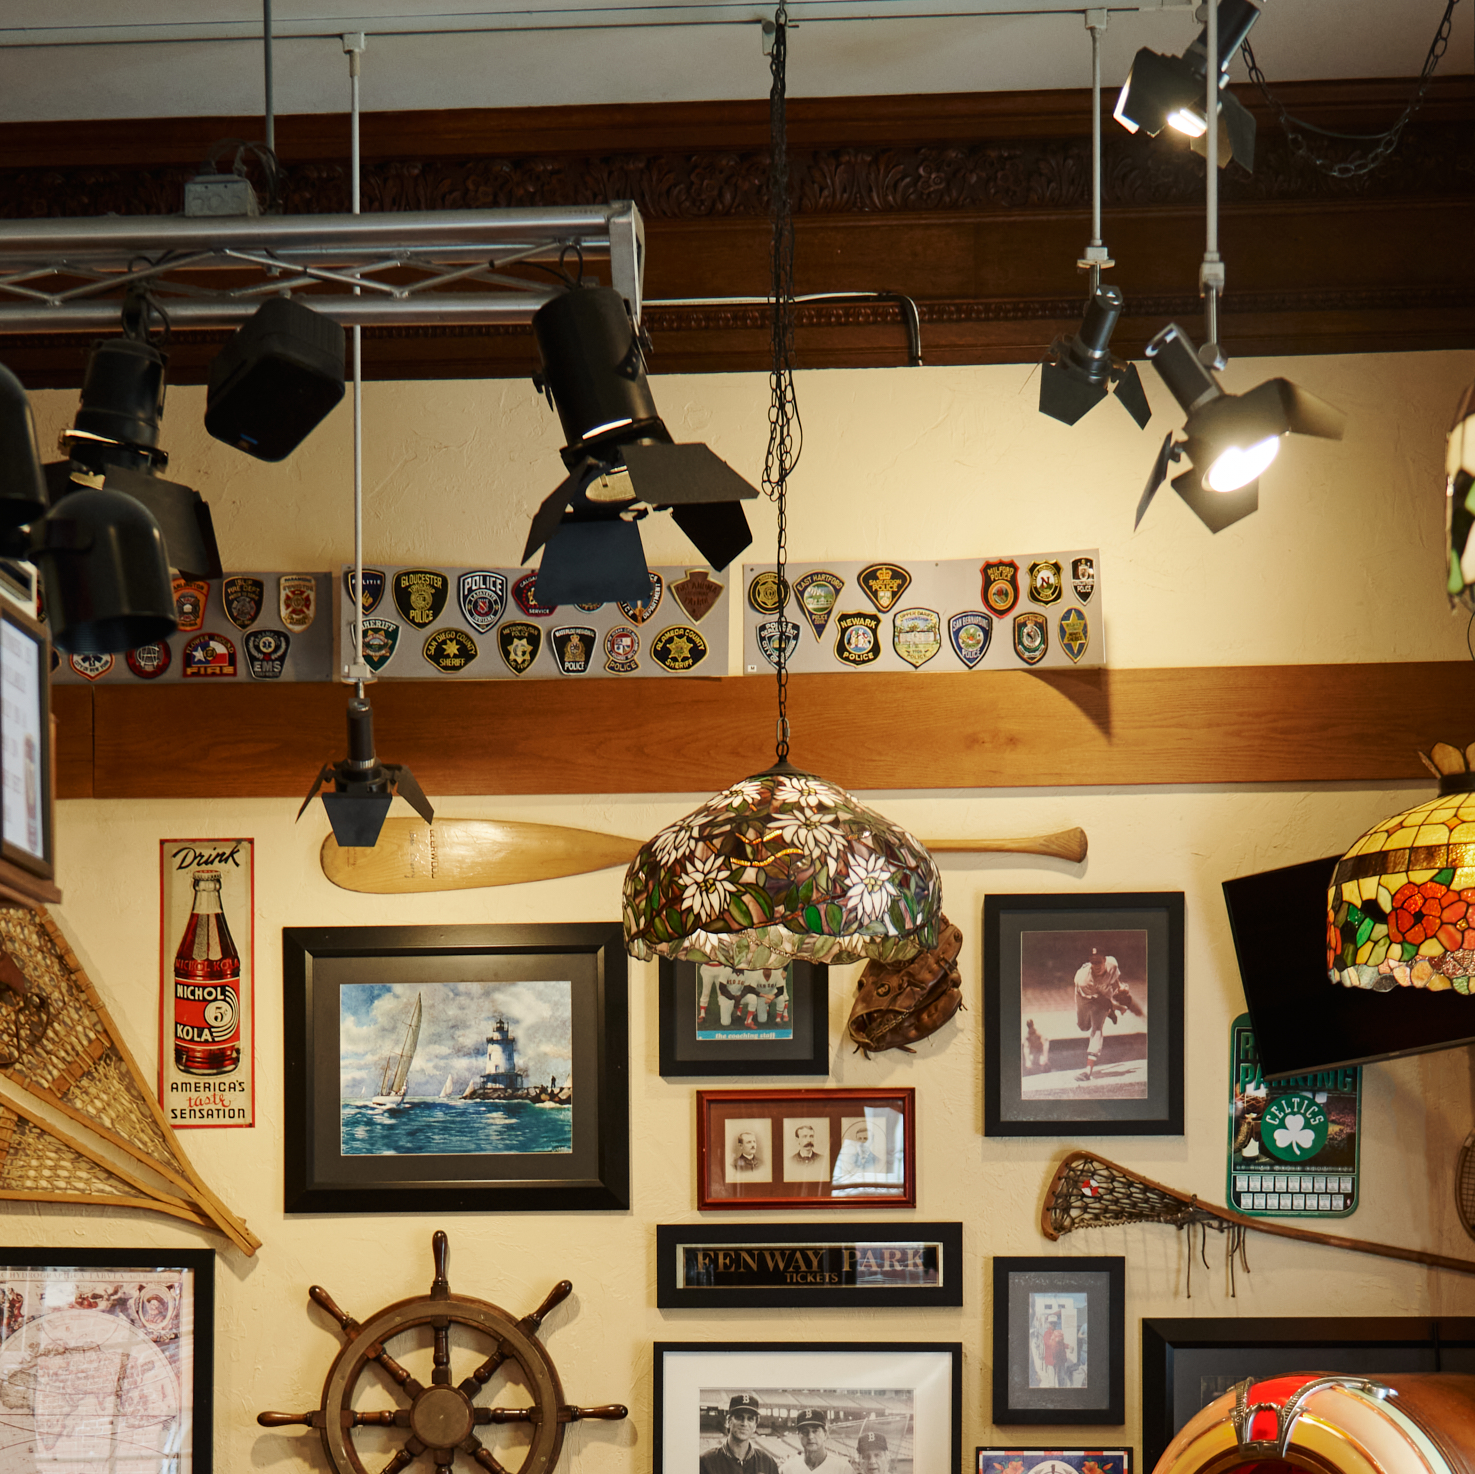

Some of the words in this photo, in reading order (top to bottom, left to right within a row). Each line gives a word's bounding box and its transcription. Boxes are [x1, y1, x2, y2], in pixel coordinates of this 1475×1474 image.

[987, 566, 1015, 576] MILFORD
[401, 573, 443, 590] GLOUCESTER
[797, 577, 812, 591] EAST
[812, 574, 843, 590] HARTFORD
[868, 578, 902, 586] SASKATOON
[990, 573, 1012, 582] POLICE
[1041, 576, 1051, 588] N
[227, 585, 241, 594] FIRE
[465, 576, 503, 596] POLICE
[872, 584, 898, 592] POLICE
[642, 583, 661, 620] DEPARTMENT
[409, 610, 434, 624] POLICE
[899, 611, 917, 620] UPPER
[840, 618, 877, 630] NEWARK
[953, 619, 963, 632] SAN
[502, 625, 539, 636] METROPOLITAN
[511, 630, 529, 638] POLICE
[186, 635, 209, 653] FLOWER
[427, 641, 438, 656] SAN
[435, 630, 456, 644] DIEGO
[456, 632, 476, 656] COUNTY
[656, 628, 684, 651] ALAMEDA
[684, 629, 705, 651] COUNTY
[762, 641, 772, 656] CITY
[962, 649, 981, 659] POLICE
[843, 651, 874, 661] POLICE
[253, 661, 282, 672] EMS
[439, 657, 465, 667] SHERIFF
[564, 661, 585, 671] POLICE
[608, 661, 637, 671] POLICE
[665, 658, 693, 669] SHERIFF
[186, 666, 235, 675] FIRE
[172, 845, 241, 871] Drink
[176, 958, 211, 971] NICHOL
[213, 958, 240, 971] KOLA
[177, 984, 225, 1000] NICHOL
[177, 1023, 213, 1042] KOLA
[728, 1032, 758, 1040] coaching
[171, 1080, 245, 1093] AMERICA'S
[186, 1092, 232, 1109] taste
[171, 1108, 245, 1119] SENSATION
[1266, 1097, 1324, 1126] CELTICS
[695, 1250, 826, 1273] FENWAY
[842, 1249, 927, 1272] PARK
[784, 1272, 839, 1283] TICKETS
[742, 1394, 750, 1404] B
[805, 1409, 813, 1418] B
[867, 1431, 875, 1442] B
